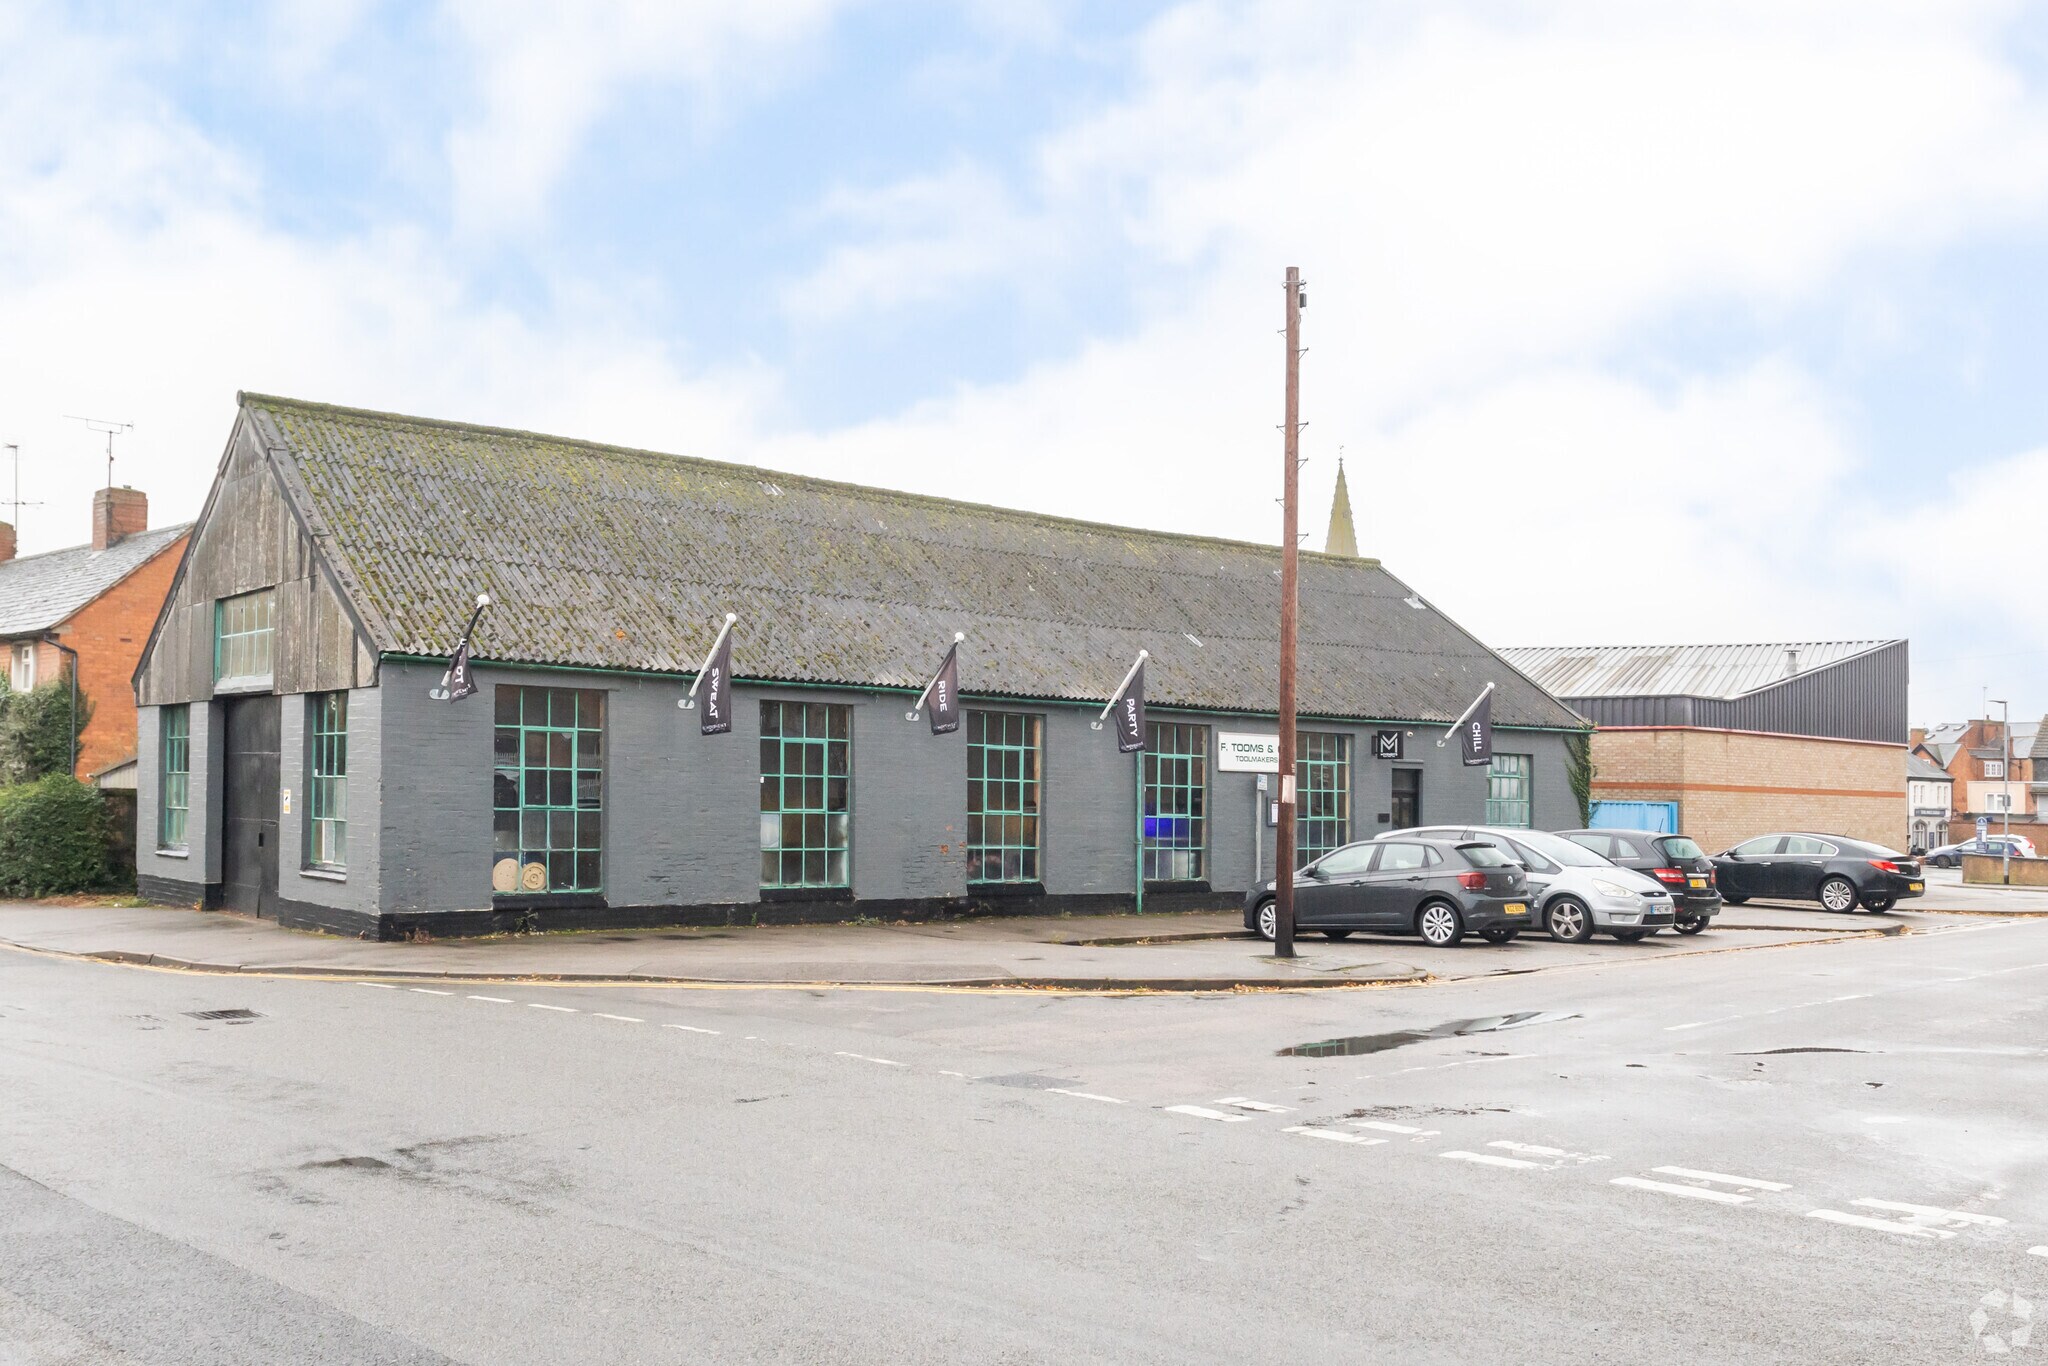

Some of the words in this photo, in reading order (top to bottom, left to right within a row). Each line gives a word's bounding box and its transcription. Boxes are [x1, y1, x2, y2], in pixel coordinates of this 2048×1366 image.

[709, 667, 720, 719] SWEAT
[938, 680, 948, 712] RIDE
[1126, 698, 1138, 737] PARTY
[1220, 742, 1228, 752] F.
[1231, 743, 1264, 753] TOOMS
[1267, 744, 1274, 754] &
[1472, 722, 1482, 753] CHILL
[1235, 755, 1278, 763] TOOLMAKERS
